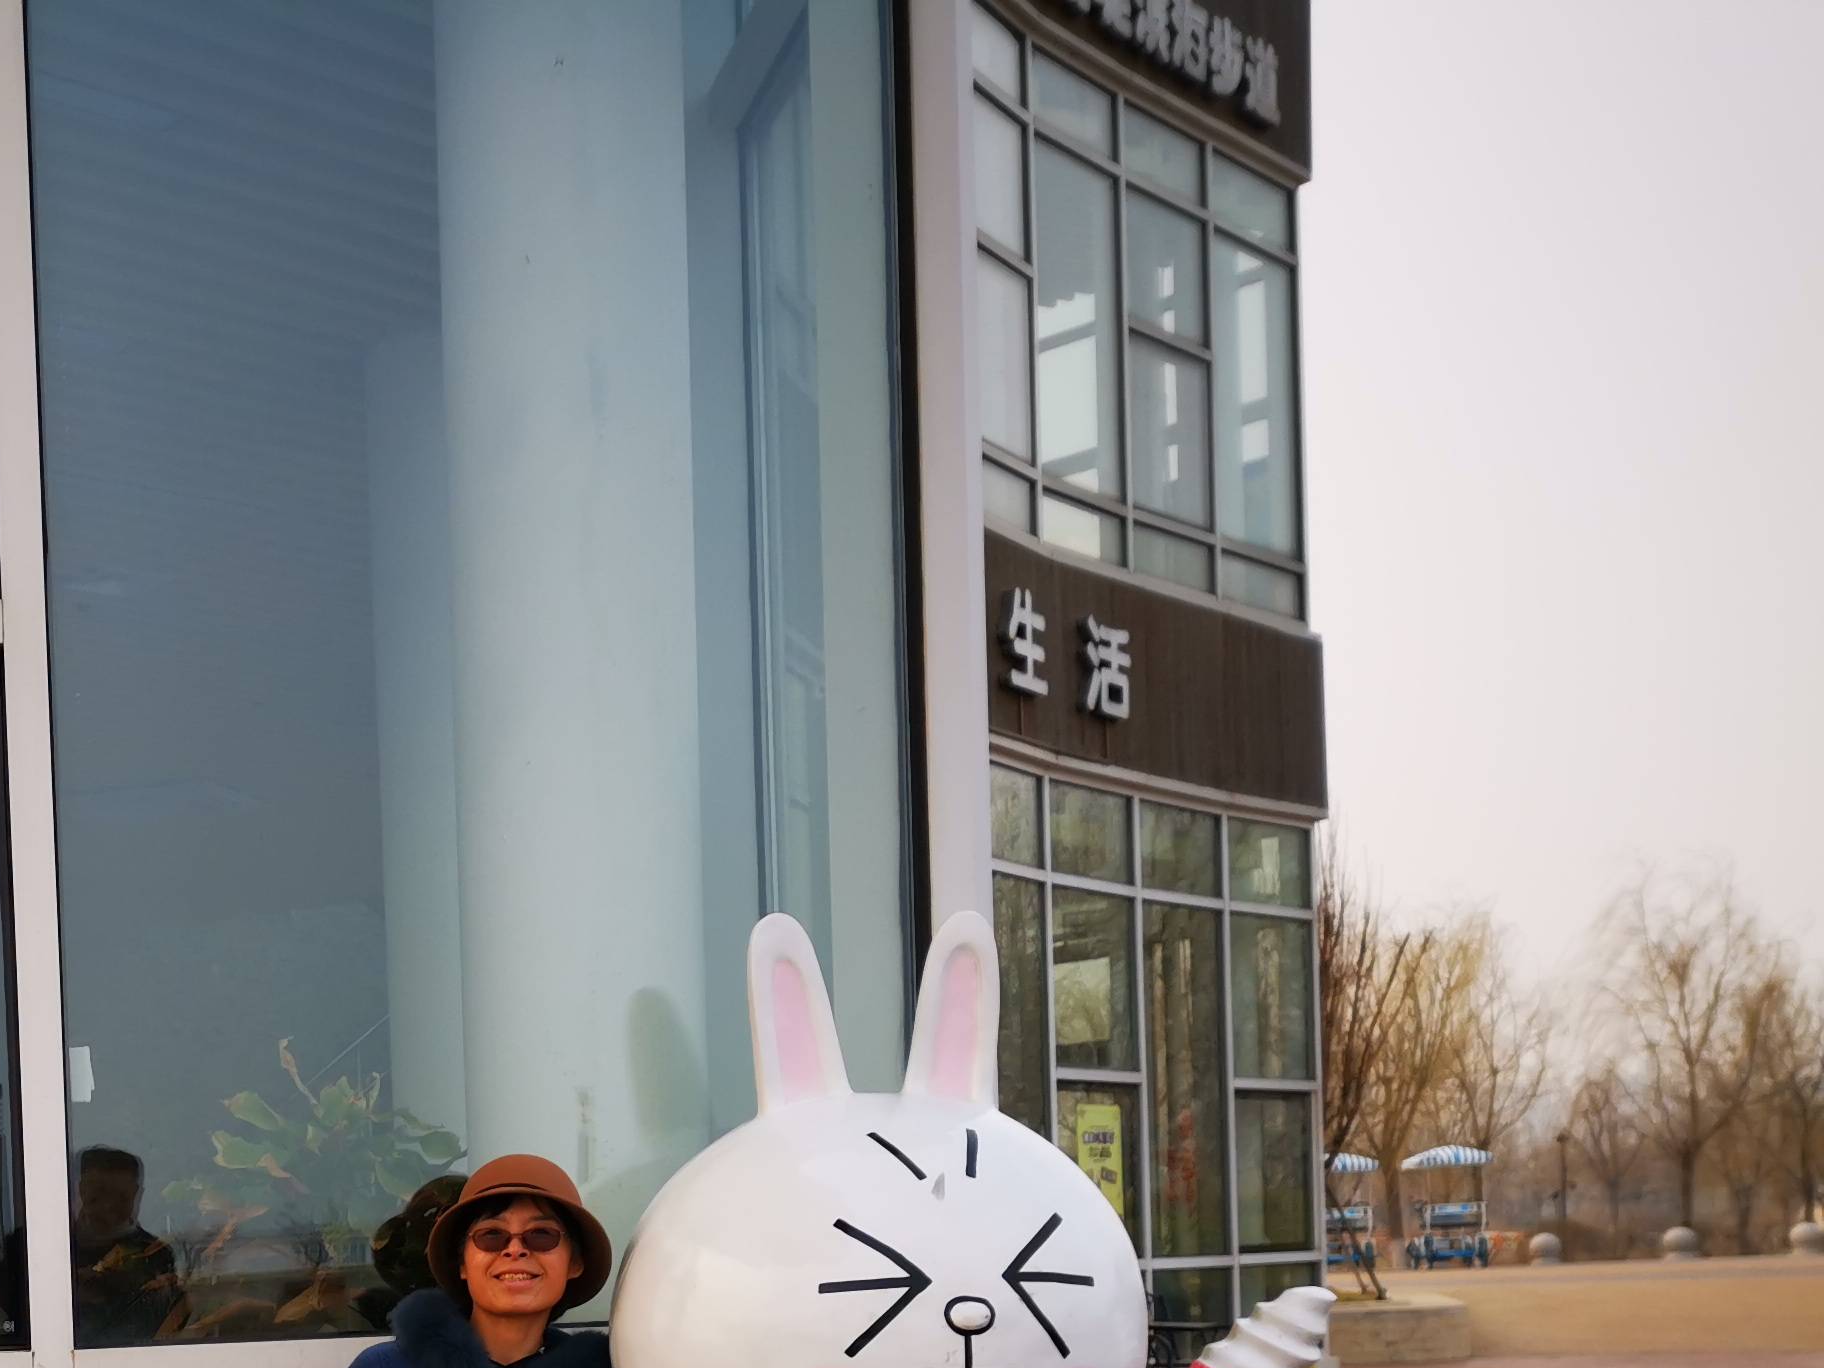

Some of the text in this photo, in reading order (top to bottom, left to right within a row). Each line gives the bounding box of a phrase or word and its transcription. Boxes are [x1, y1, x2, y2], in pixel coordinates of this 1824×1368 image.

[1072, 0, 1281, 128] 滨海步道
[1007, 586, 1132, 719] 生活
